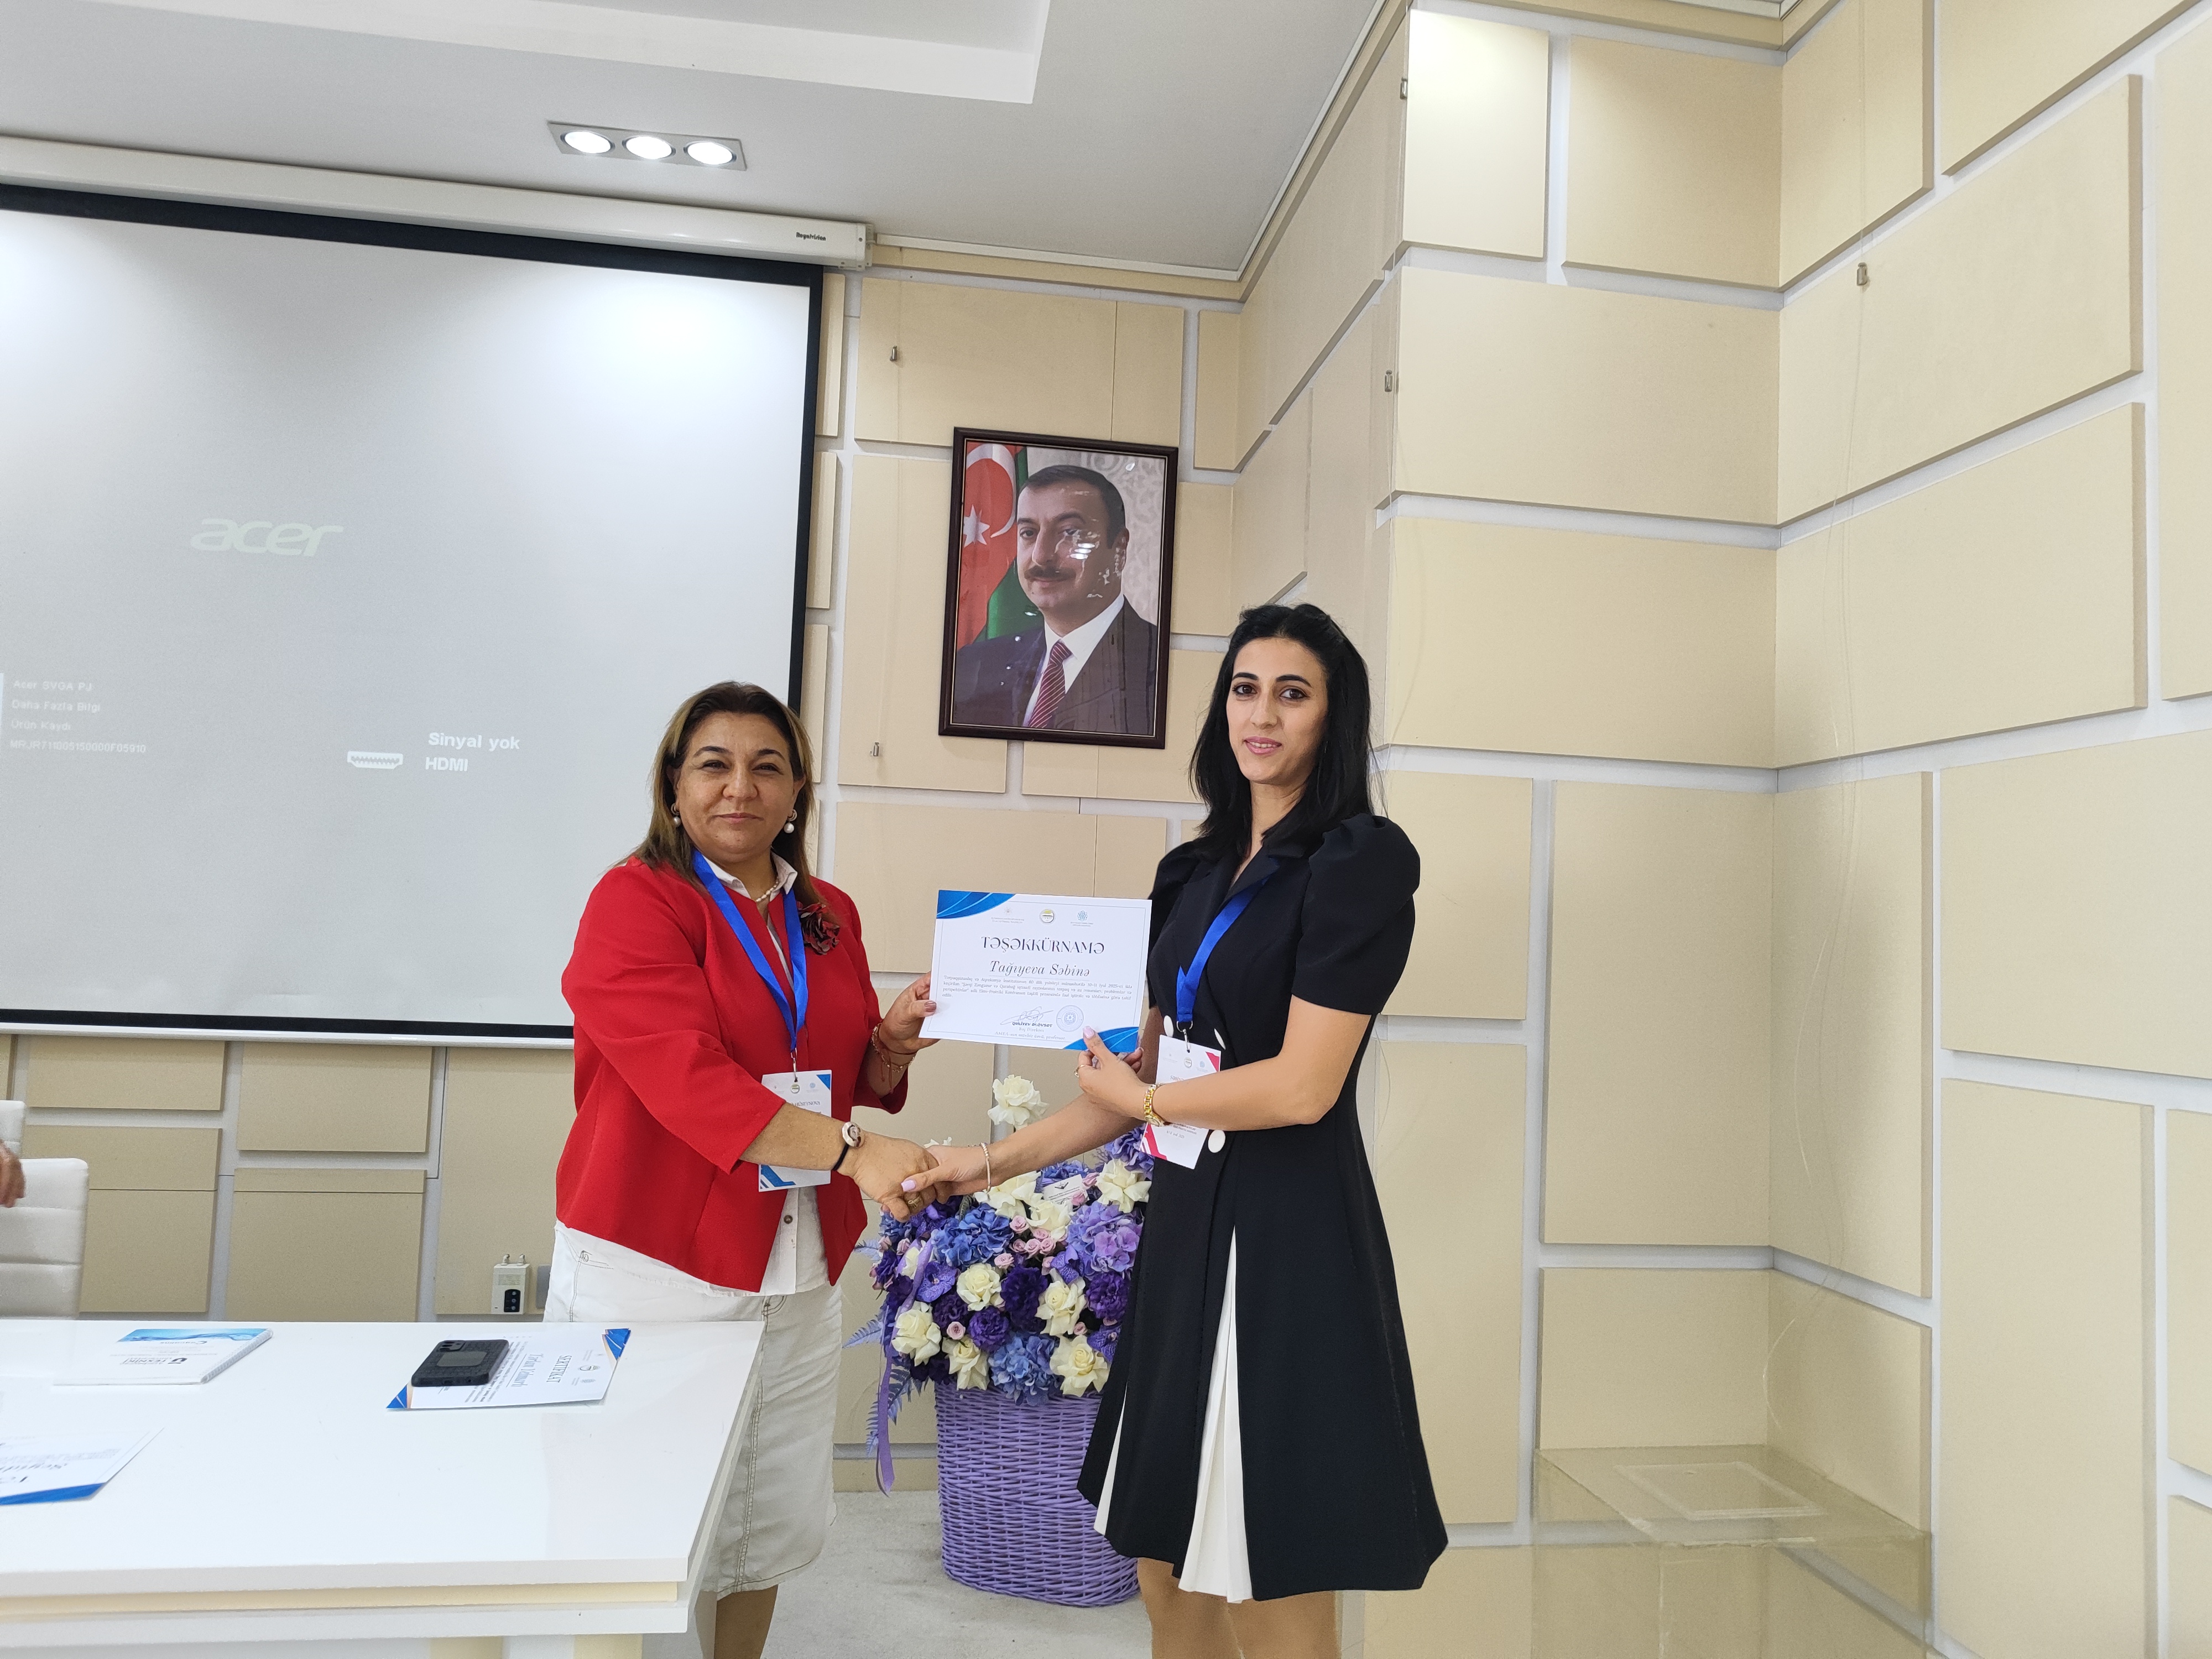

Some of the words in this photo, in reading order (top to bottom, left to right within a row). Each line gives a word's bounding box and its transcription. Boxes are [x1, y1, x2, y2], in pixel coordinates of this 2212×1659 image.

[190, 518, 344, 557] acer
[13, 680, 37, 689] Acer
[43, 681, 74, 691] SVGA
[78, 682, 93, 692] PJ
[12, 700, 39, 709] Daha
[44, 701, 72, 711] Fazla
[77, 702, 101, 713] Bilgi
[428, 732, 482, 750] Sinyal
[489, 736, 520, 752] yok
[425, 757, 468, 772] HDMI
[981, 936, 1104, 954] TƏŞƏKKÜRNAMƏ
[1049, 963, 1089, 977] Səbinə
